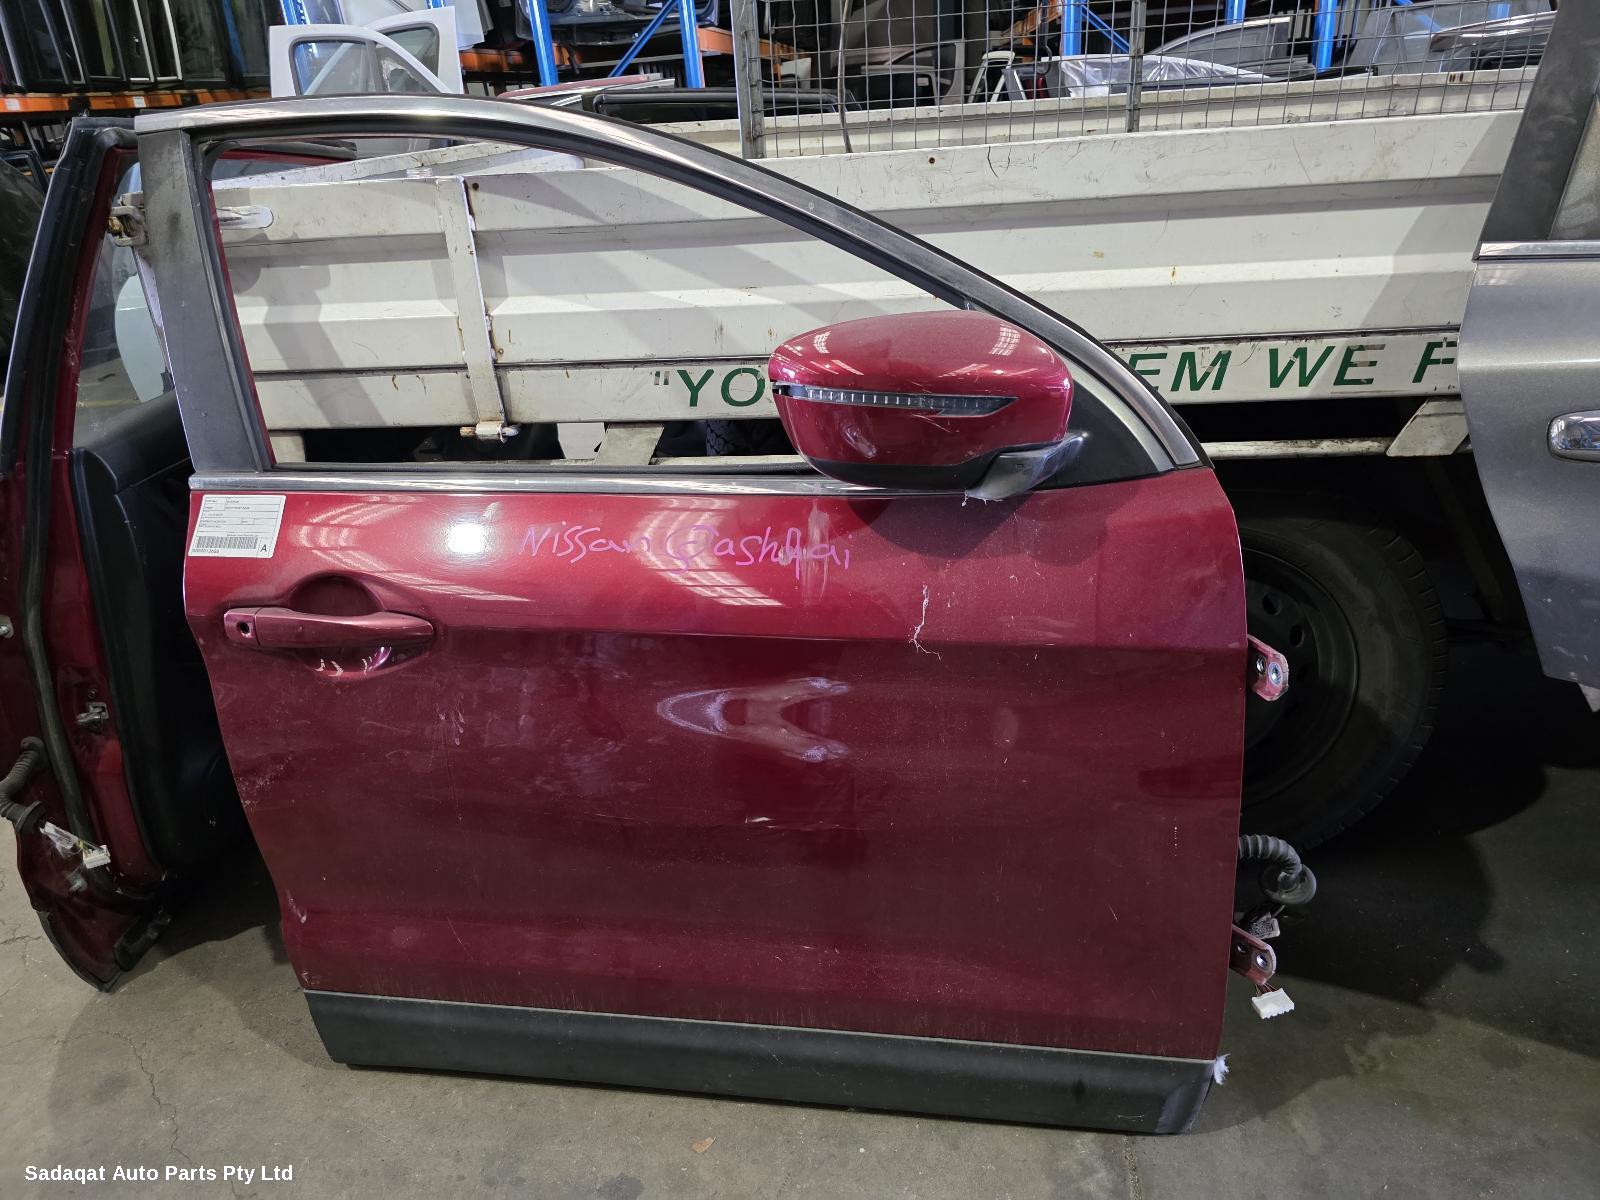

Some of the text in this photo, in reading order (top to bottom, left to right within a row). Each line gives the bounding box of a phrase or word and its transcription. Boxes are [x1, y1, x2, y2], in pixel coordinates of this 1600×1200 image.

[654, 340, 1458, 407] "YO EM WE F
[519, 520, 650, 564] Nissan
